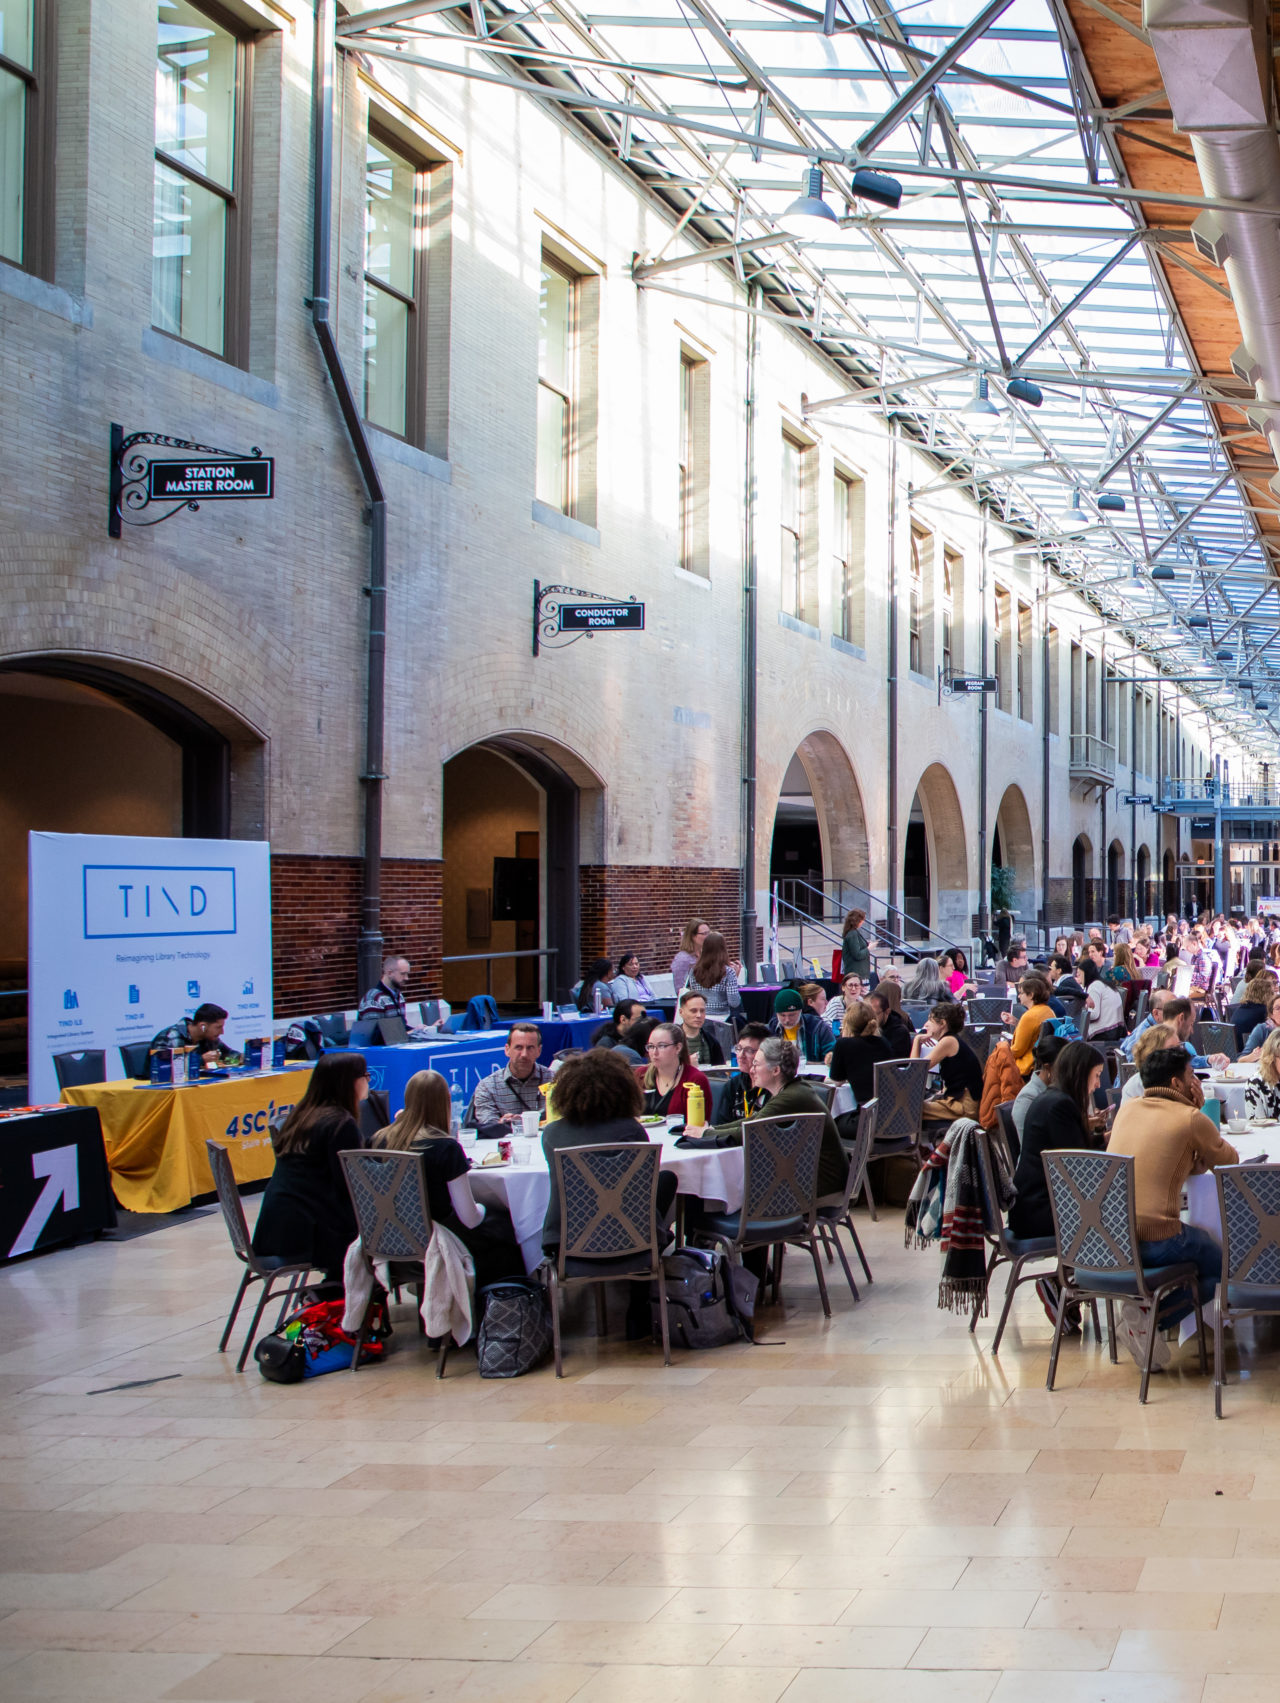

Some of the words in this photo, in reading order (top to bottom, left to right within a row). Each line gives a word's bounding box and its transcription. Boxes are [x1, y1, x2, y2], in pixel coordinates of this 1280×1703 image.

[184, 467, 235, 479] STATION
[165, 480, 213, 492] MASTER
[215, 479, 255, 491] ROOM
[574, 608, 629, 618] CONDUCTOR
[588, 617, 616, 626] ROOM
[115, 954, 155, 964] Reimagining
[155, 952, 176, 962] Library
[176, 951, 211, 960] Technology
